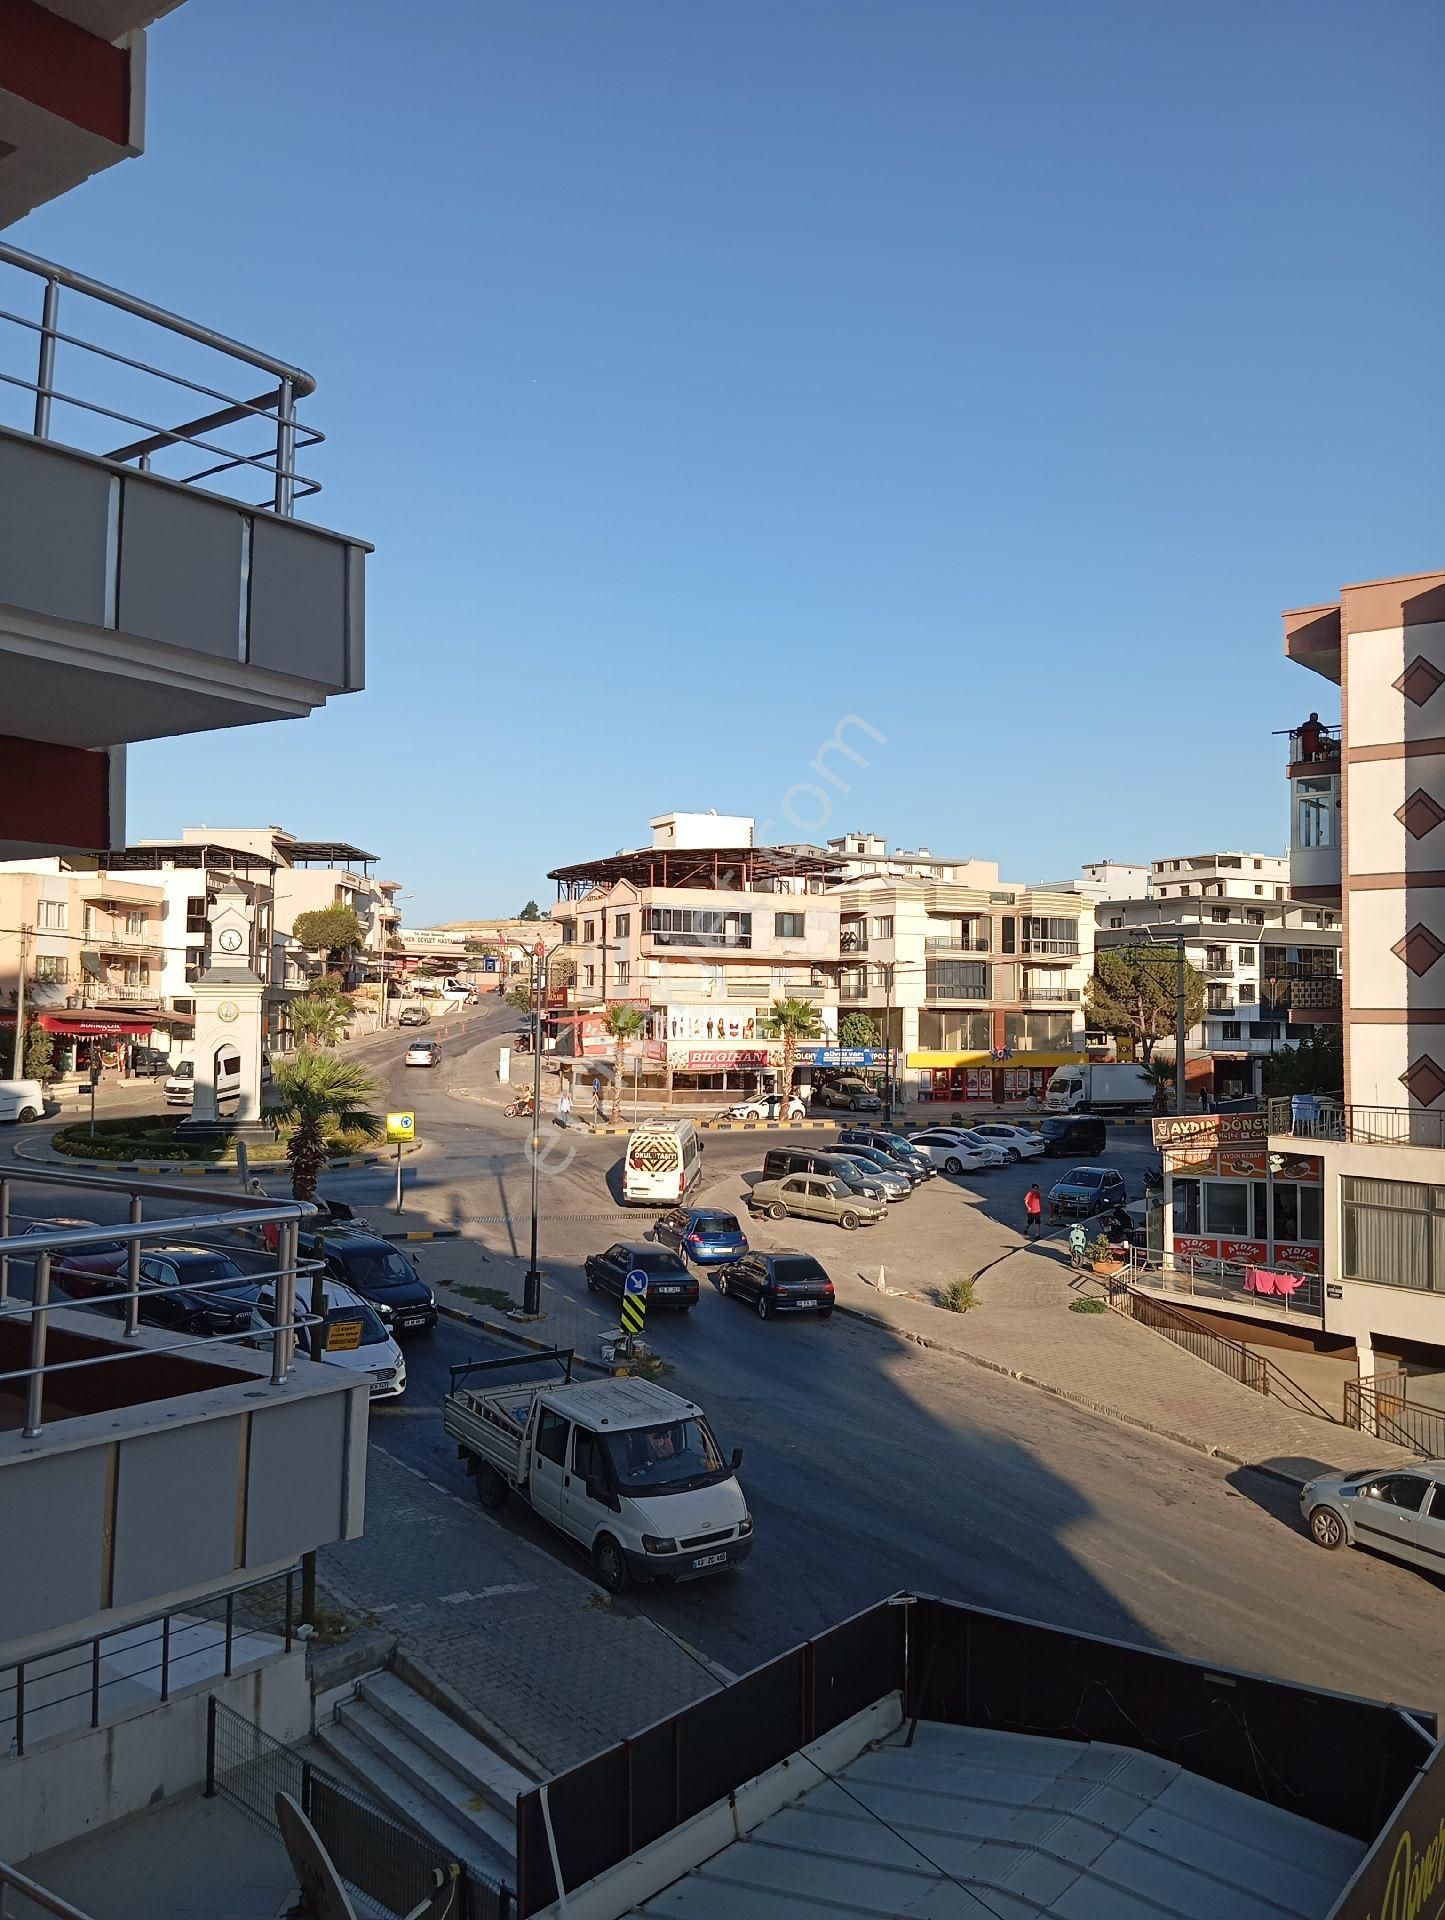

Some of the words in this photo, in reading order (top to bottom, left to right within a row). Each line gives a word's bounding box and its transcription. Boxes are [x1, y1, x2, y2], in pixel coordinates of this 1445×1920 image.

[691, 1050, 765, 1062] BİLGİHAN
[873, 1052, 894, 1060] POLN
[1171, 1120, 1216, 1135] AYDIN
[1180, 1239, 1211, 1250] AYDIN
[1228, 1243, 1260, 1254] AYDIN
[1281, 1247, 1314, 1258] AYDIN
